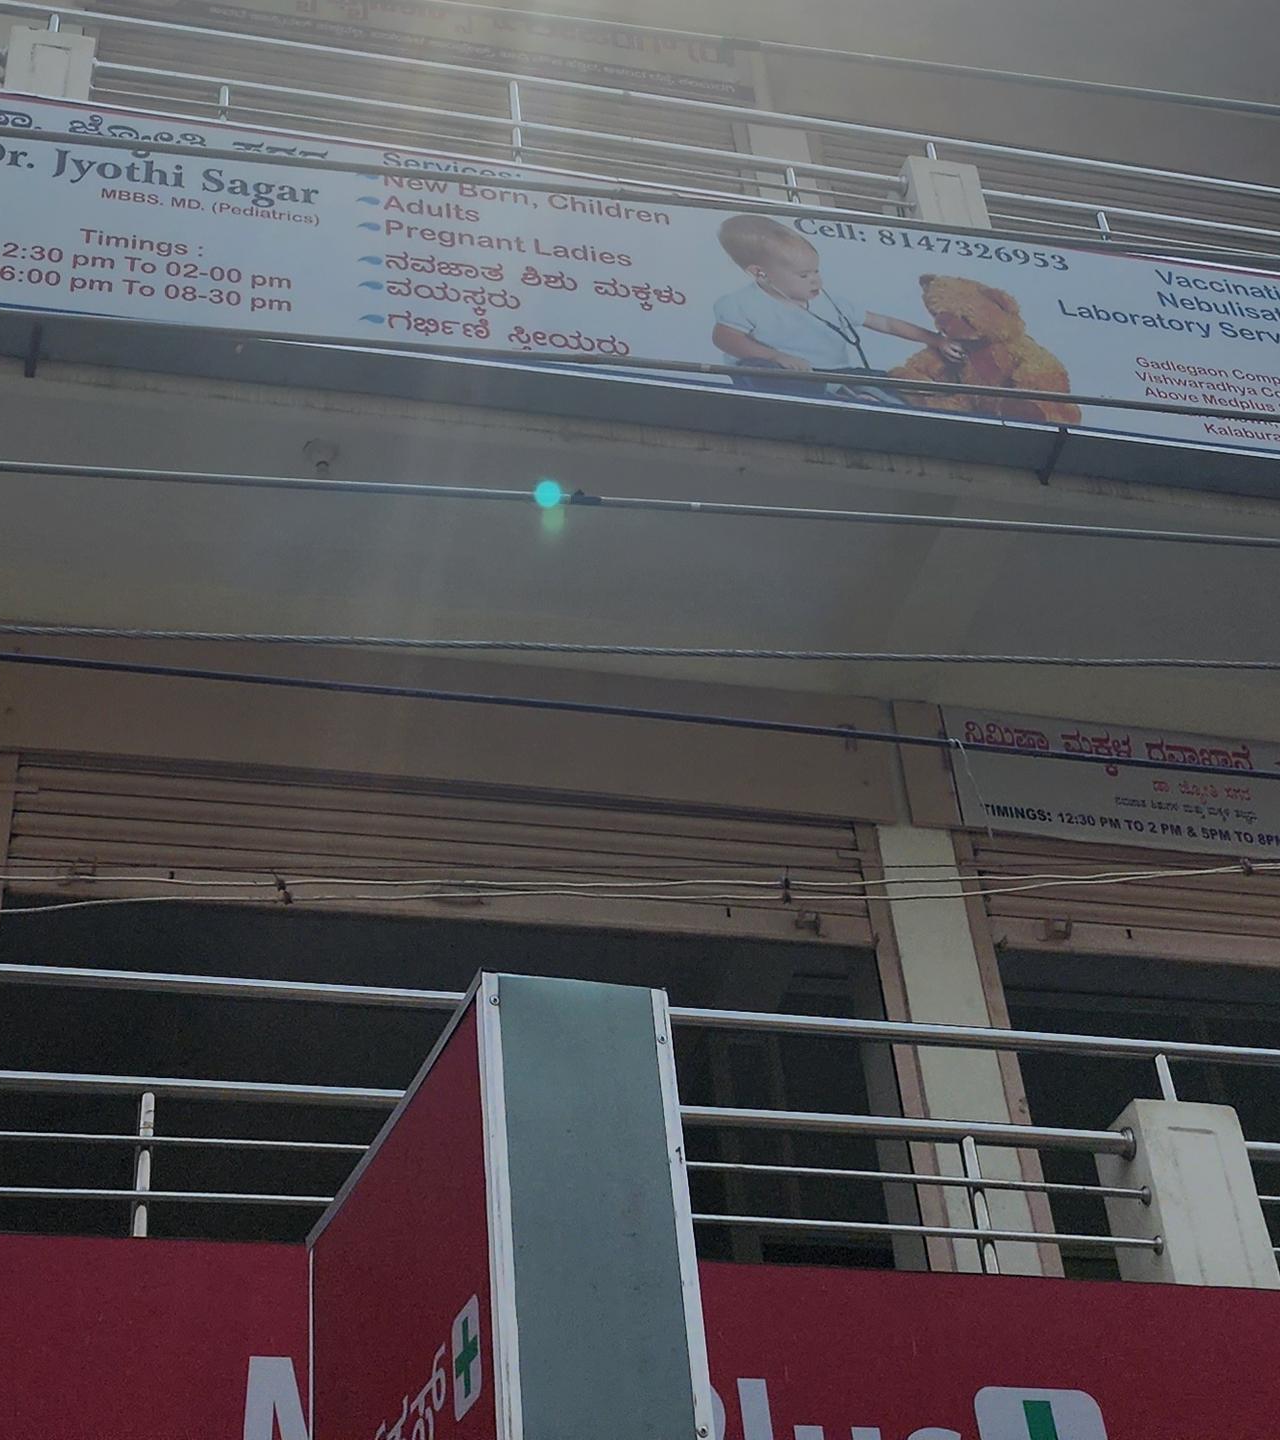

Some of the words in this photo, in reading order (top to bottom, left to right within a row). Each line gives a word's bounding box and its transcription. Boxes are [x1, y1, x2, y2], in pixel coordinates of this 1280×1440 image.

[52, 148, 185, 189] Jyothi
[202, 169, 320, 208] Sagar
[101, 188, 164, 206] MBBS.
[171, 197, 205, 212] MD.
[212, 201, 321, 226] (Pediatrics)
[384, 175, 448, 194] New
[458, 182, 538, 209] Born,
[548, 195, 670, 225] Children
[384, 195, 480, 223] Adults
[80, 227, 188, 258] Timings
[385, 219, 526, 254] Pregnant
[535, 238, 632, 267] Ladies
[793, 215, 867, 244] Cell:
[878, 228, 1070, 273] 8147326953
[72, 252, 116, 274] pm
[123, 255, 158, 276] To
[164, 259, 242, 285] 02-00
[250, 271, 293, 291] pm
[385, 252, 503, 282] ನವಜಾತ
[521, 266, 578, 292] ಶಿಶು
[594, 279, 687, 311] ಮಕ್ಕಳು
[69, 275, 114, 297] pm
[121, 277, 157, 298] To
[162, 282, 242, 309] 08-30
[250, 294, 293, 314] pm
[1057, 299, 1212, 340] Laboratory
[1135, 356, 1228, 380] Gadlegaon
[1135, 370, 1259, 397] Vishwaradhya
[1144, 386, 1199, 404] Above
[1202, 393, 1275, 414] Medplus
[982, 803, 1053, 824] TIMINGS:
[1057, 812, 1096, 827] 12:30
[1099, 815, 1122, 830] PM
[1125, 818, 1144, 833] TO
[1160, 823, 1182, 837] PM
[1201, 827, 1231, 842] 5PM
[1235, 830, 1254, 845] TO
